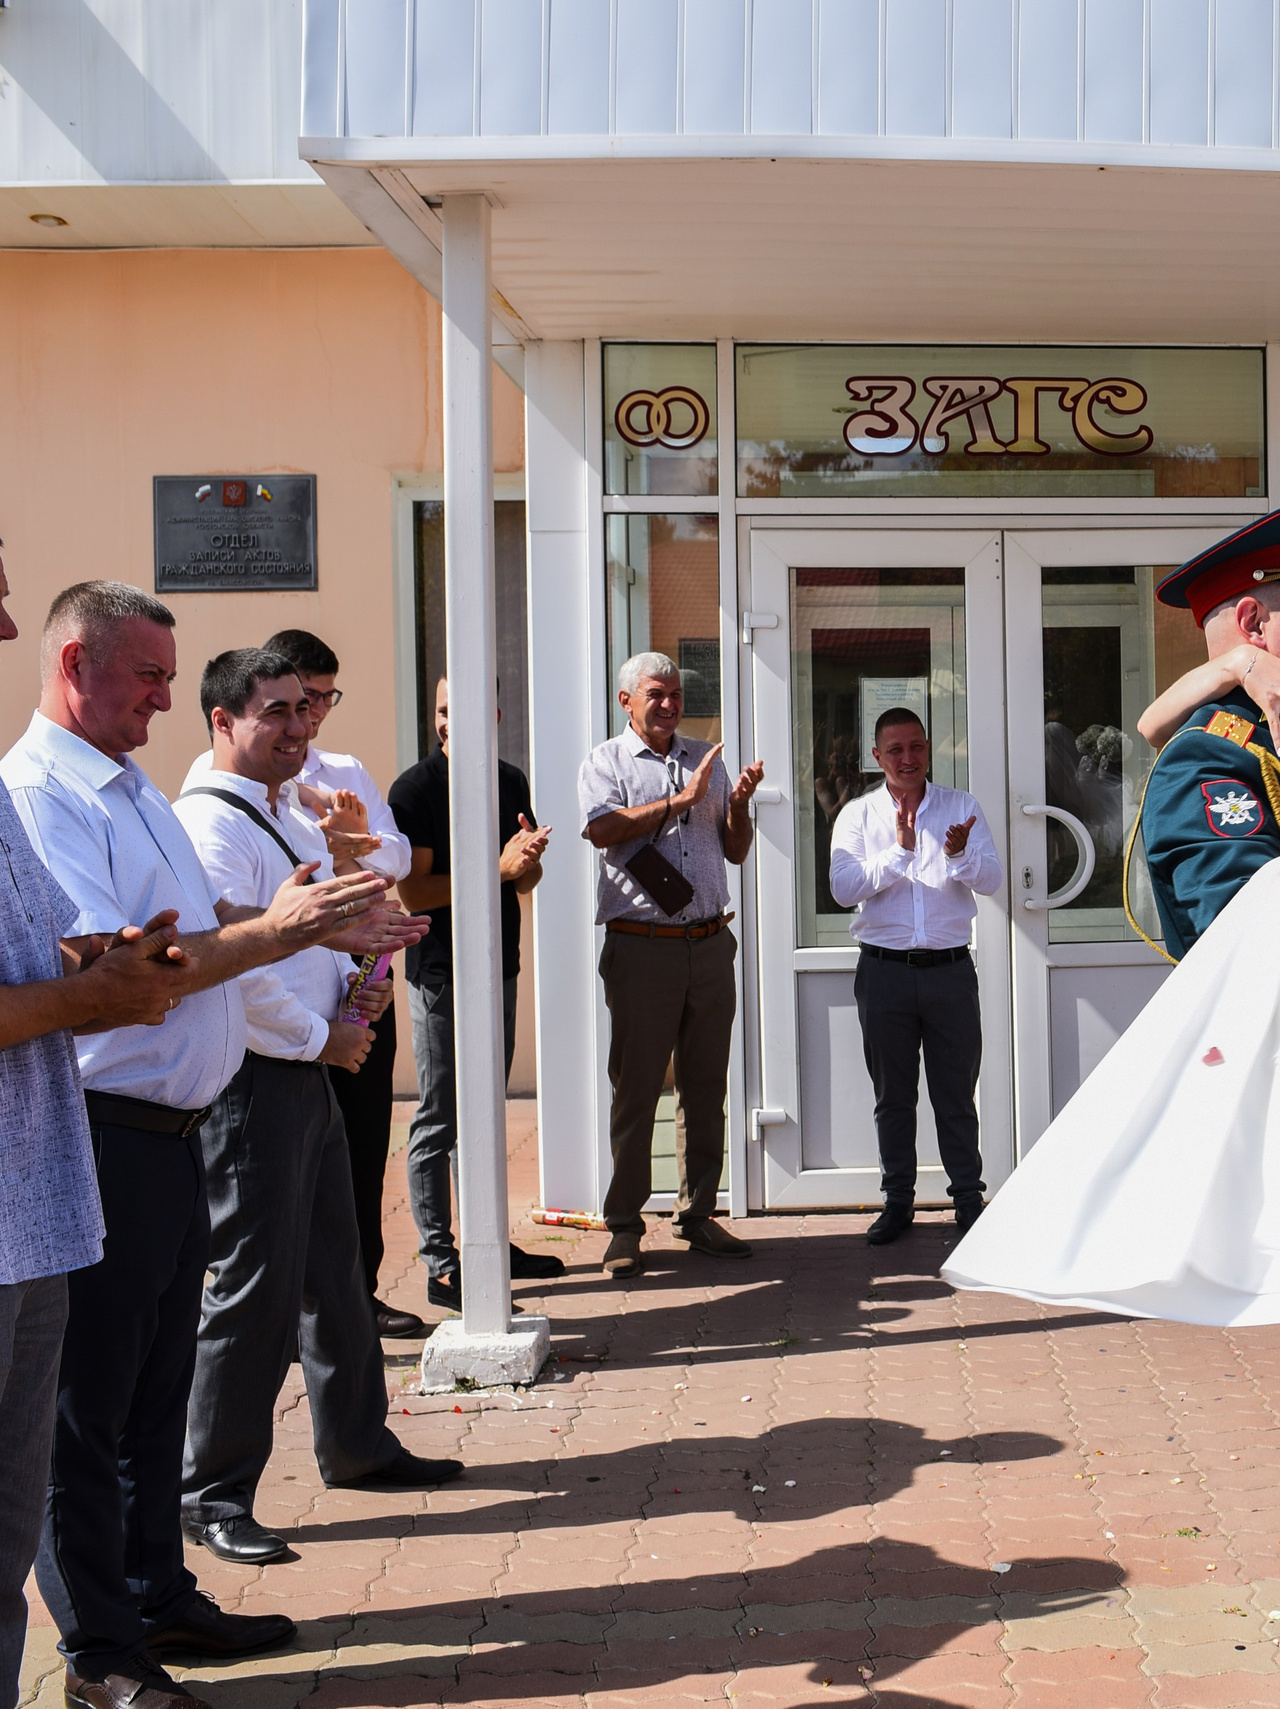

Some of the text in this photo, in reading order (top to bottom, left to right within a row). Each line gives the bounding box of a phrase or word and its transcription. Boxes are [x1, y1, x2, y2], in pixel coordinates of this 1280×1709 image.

[842, 376, 1154, 456] ЗАГС
[210, 534, 259, 549] ОТДЕЛ
[189, 550, 281, 562] ЗАПИСИ АКТОВ
[160, 563, 311, 576] ГРАЖДАНСКОГО СОСТОЯНИЯ
